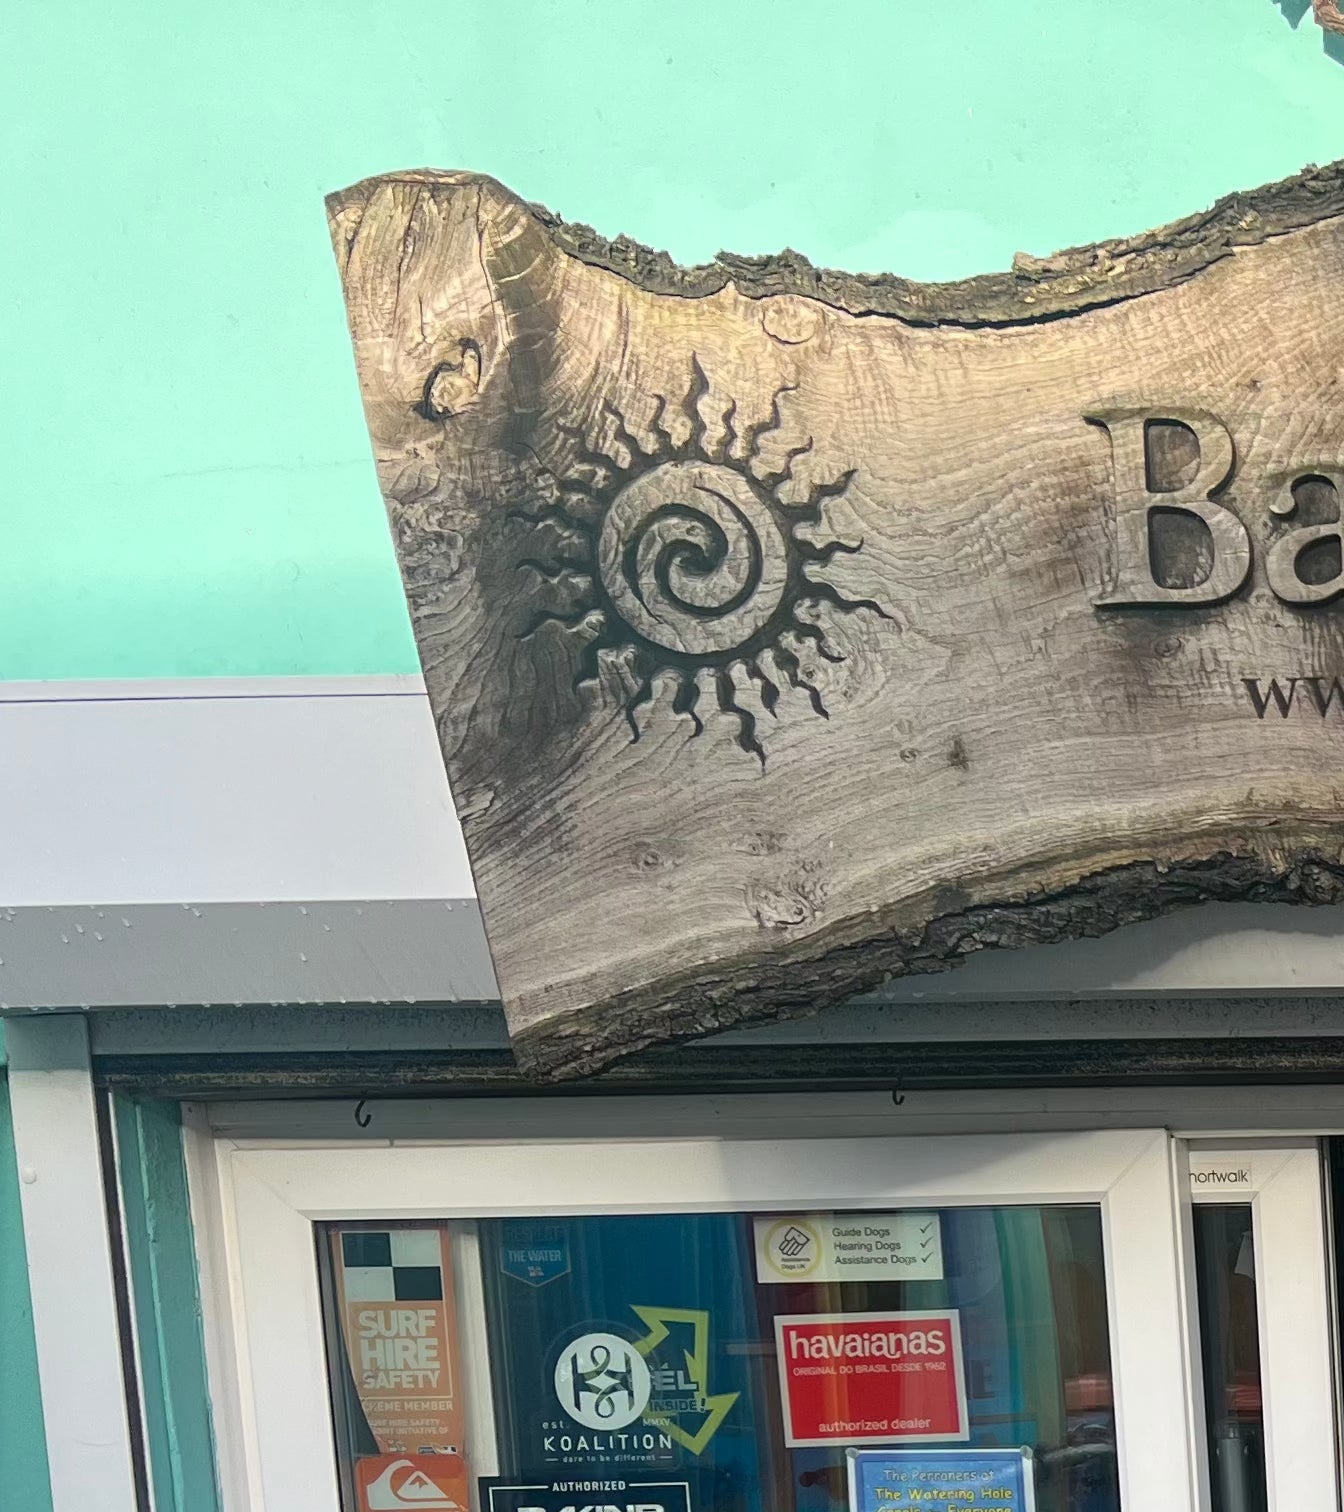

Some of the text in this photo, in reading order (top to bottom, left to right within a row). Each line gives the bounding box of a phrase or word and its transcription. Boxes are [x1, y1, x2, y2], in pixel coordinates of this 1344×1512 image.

[1188, 1169, 1249, 1183] hortwalk
[832, 1227, 891, 1239] Guide Dogs
[833, 1241, 902, 1252] Hearing Dogs
[834, 1255, 917, 1266] Assistance Dogs
[358, 1309, 437, 1338] SURF
[789, 1329, 946, 1359] havaianas
[360, 1338, 441, 1370] HIRE
[793, 1367, 837, 1376] ORIGINAL
[839, 1366, 853, 1375] DO
[855, 1364, 890, 1374] BRASIL
[891, 1363, 922, 1373] DESDE
[362, 1370, 441, 1390] SAFETY
[404, 1400, 454, 1412] MEMBER
[819, 1418, 932, 1433] authorized dealer
[543, 1433, 673, 1452] KOALITION
[883, 1469, 907, 1481] The
[552, 1480, 626, 1492] AUTHORIZED
[875, 1487, 1013, 1503] The Watering Hole
